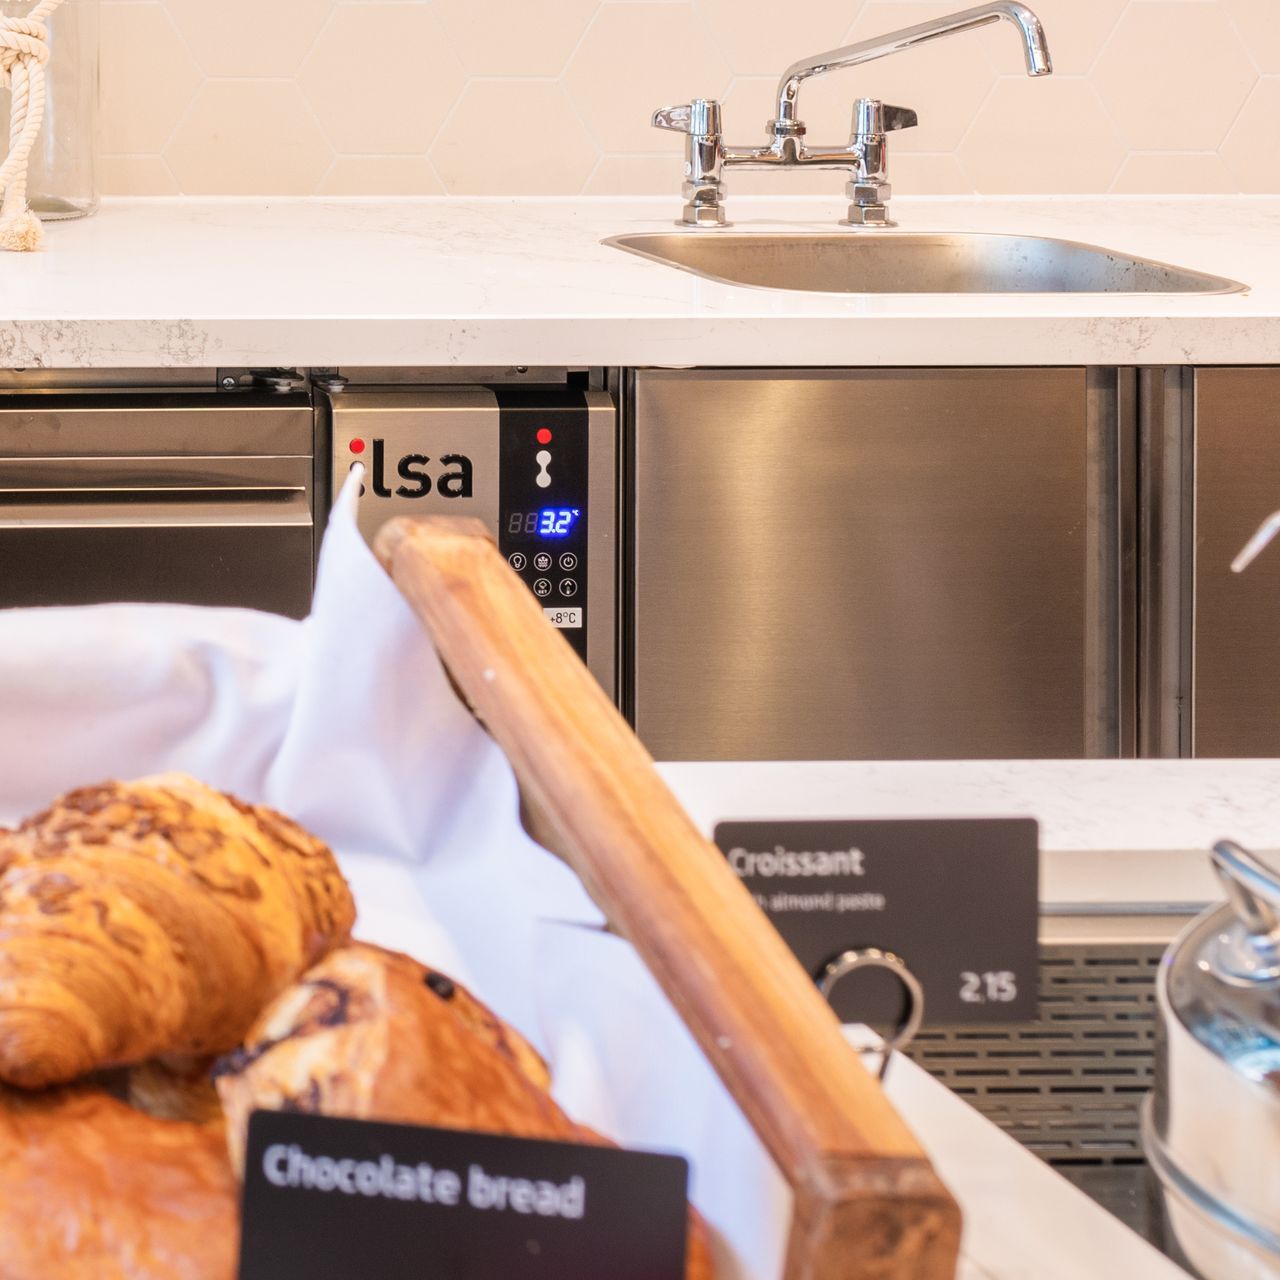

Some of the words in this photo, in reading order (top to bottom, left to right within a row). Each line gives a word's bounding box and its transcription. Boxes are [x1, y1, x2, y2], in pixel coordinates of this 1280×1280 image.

[726, 846, 866, 878] Croissant
[770, 891, 834, 912] almond
[836, 893, 886, 914] paste
[262, 1142, 463, 1206] Chocolate
[466, 1164, 587, 1221] bread
